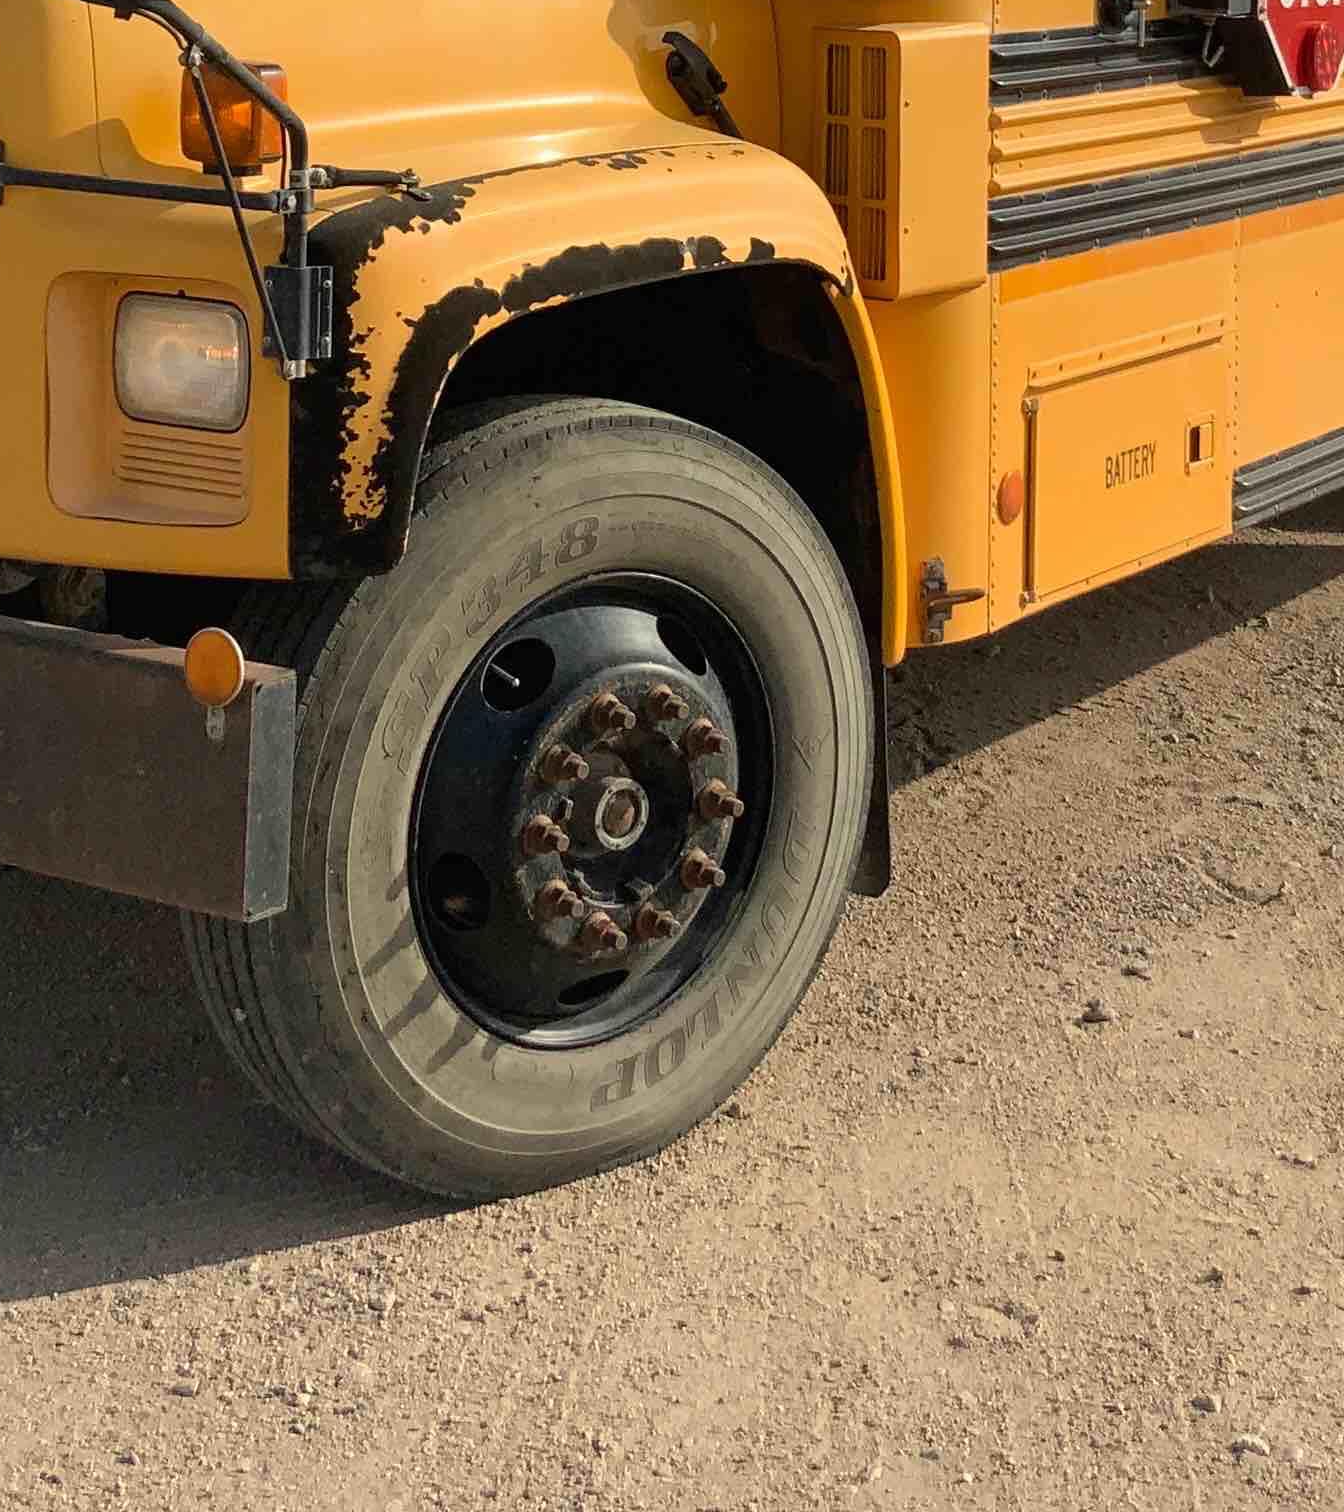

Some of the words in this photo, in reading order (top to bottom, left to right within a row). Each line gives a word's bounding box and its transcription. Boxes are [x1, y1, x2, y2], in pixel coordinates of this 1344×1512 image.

[1105, 440, 1157, 489] BATTERY
[459, 514, 600, 639] 348
[589, 809, 816, 1113] DUNLOP
